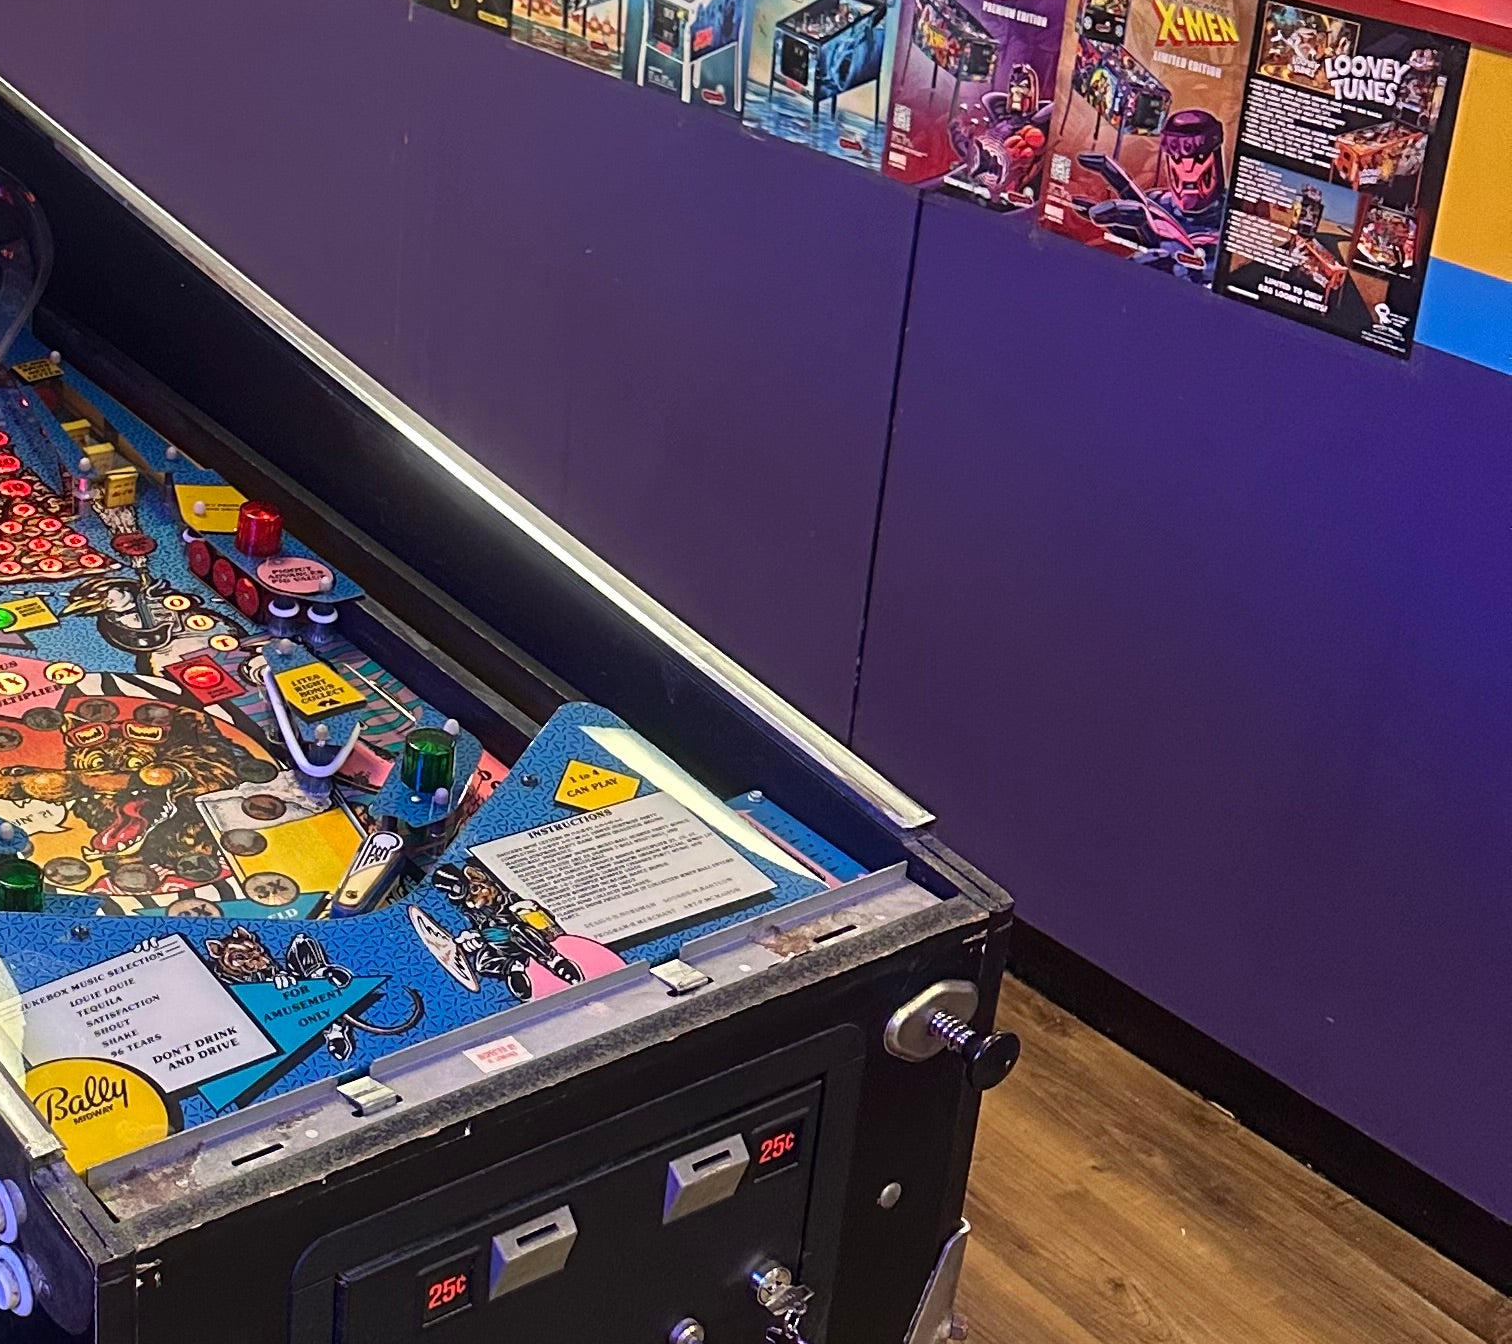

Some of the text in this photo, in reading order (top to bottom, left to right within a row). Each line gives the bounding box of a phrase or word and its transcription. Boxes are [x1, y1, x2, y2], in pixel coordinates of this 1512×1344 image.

[1151, 0, 1240, 47] X-MEN
[1324, 54, 1411, 84] LOONEY
[1330, 77, 1398, 106] TUNES
[174, 598, 184, 608] O
[192, 618, 207, 628] U
[215, 638, 229, 647] T
[290, 673, 322, 687] LITES
[294, 678, 328, 694] RIGHT
[298, 683, 336, 698] BONUS
[299, 687, 346, 705] COLLECT
[566, 777, 619, 798] CAN PLAY
[569, 775, 577, 784] 1
[591, 768, 601, 777] 4
[528, 808, 613, 839] INSTRUCTIONS
[71, 972, 106, 992] MUSIC
[107, 951, 165, 979] SELECTION
[69, 977, 136, 1008] LOUIE LOUIE
[282, 985, 310, 1001] FOR
[76, 995, 123, 1018] TEQUILA
[86, 994, 161, 1028] SATISFACTION
[263, 988, 344, 1022] AMUSEMENT
[93, 1018, 131, 1038] SHOUT
[298, 1008, 333, 1028] ONLY
[101, 1029, 139, 1049] SHAKE
[110, 1033, 162, 1058] 96 TEARS
[152, 1025, 238, 1065] DON'T DRINK
[168, 1038, 240, 1072] AND DRIVE
[32, 1075, 129, 1125] Bally
[73, 1103, 114, 1126] MIDWAY
[758, 1131, 795, 1165] 25¢
[428, 1273, 467, 1309] 25¢
